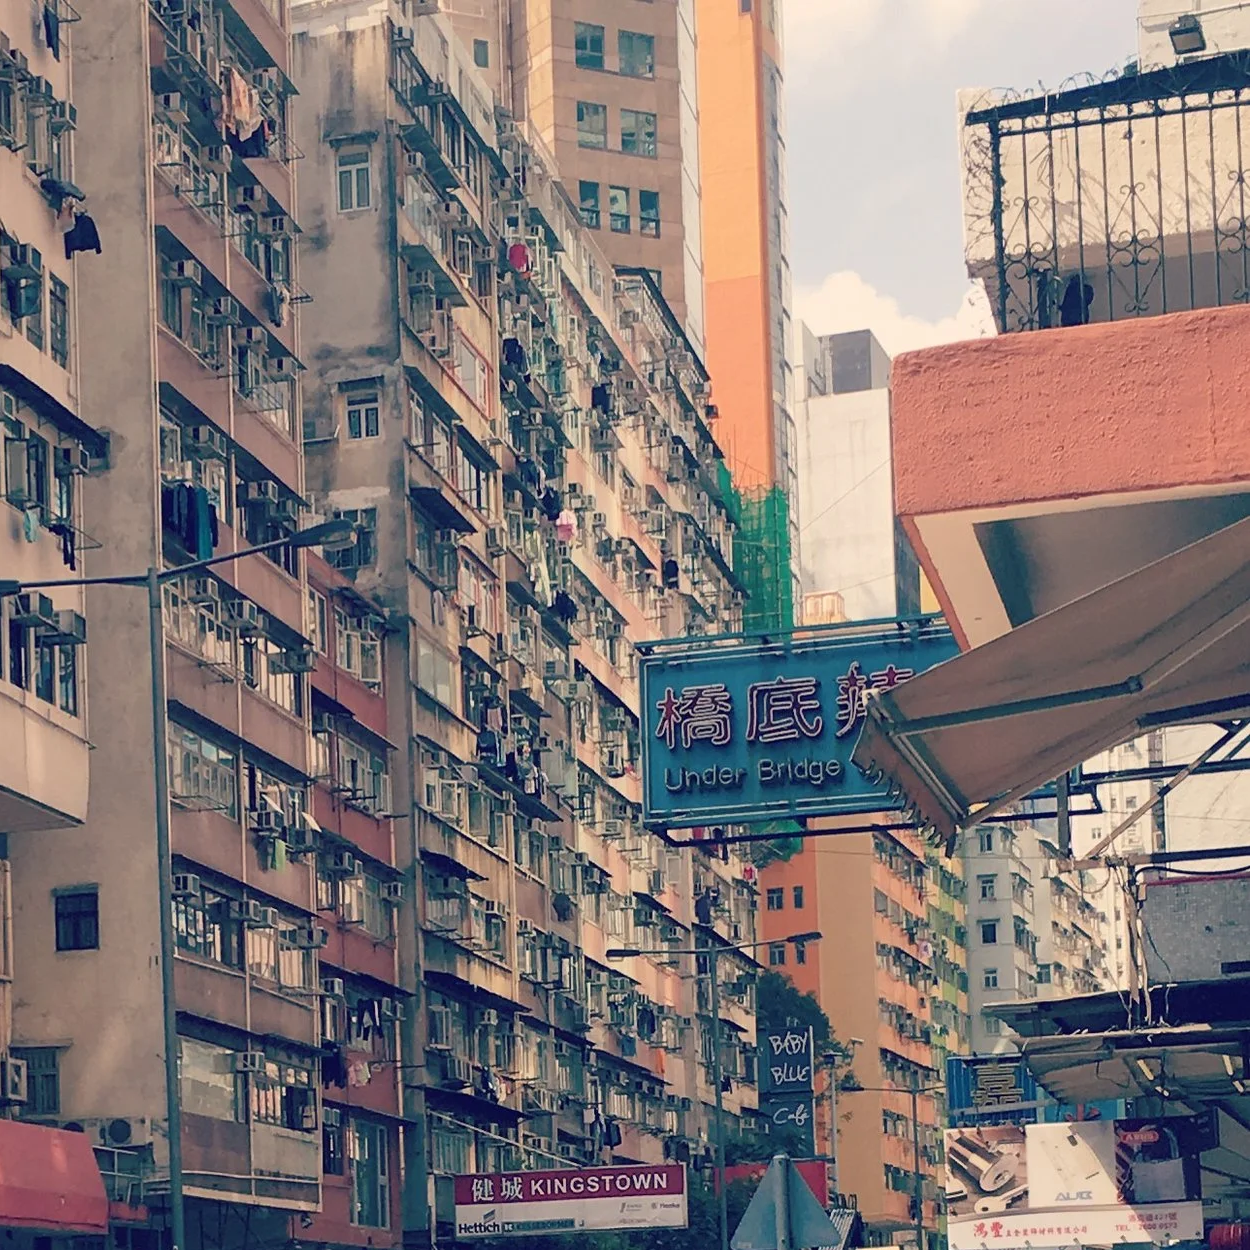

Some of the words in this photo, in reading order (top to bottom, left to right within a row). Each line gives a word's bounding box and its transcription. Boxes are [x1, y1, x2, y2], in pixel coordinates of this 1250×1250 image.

[664, 764, 747, 791] Under
[757, 757, 842, 785] Bridge
[768, 1031, 808, 1056] BABY
[770, 1062, 810, 1086] BLUE
[530, 1173, 668, 1196] KINGSTOWN
[458, 1219, 500, 1235] Hettich
